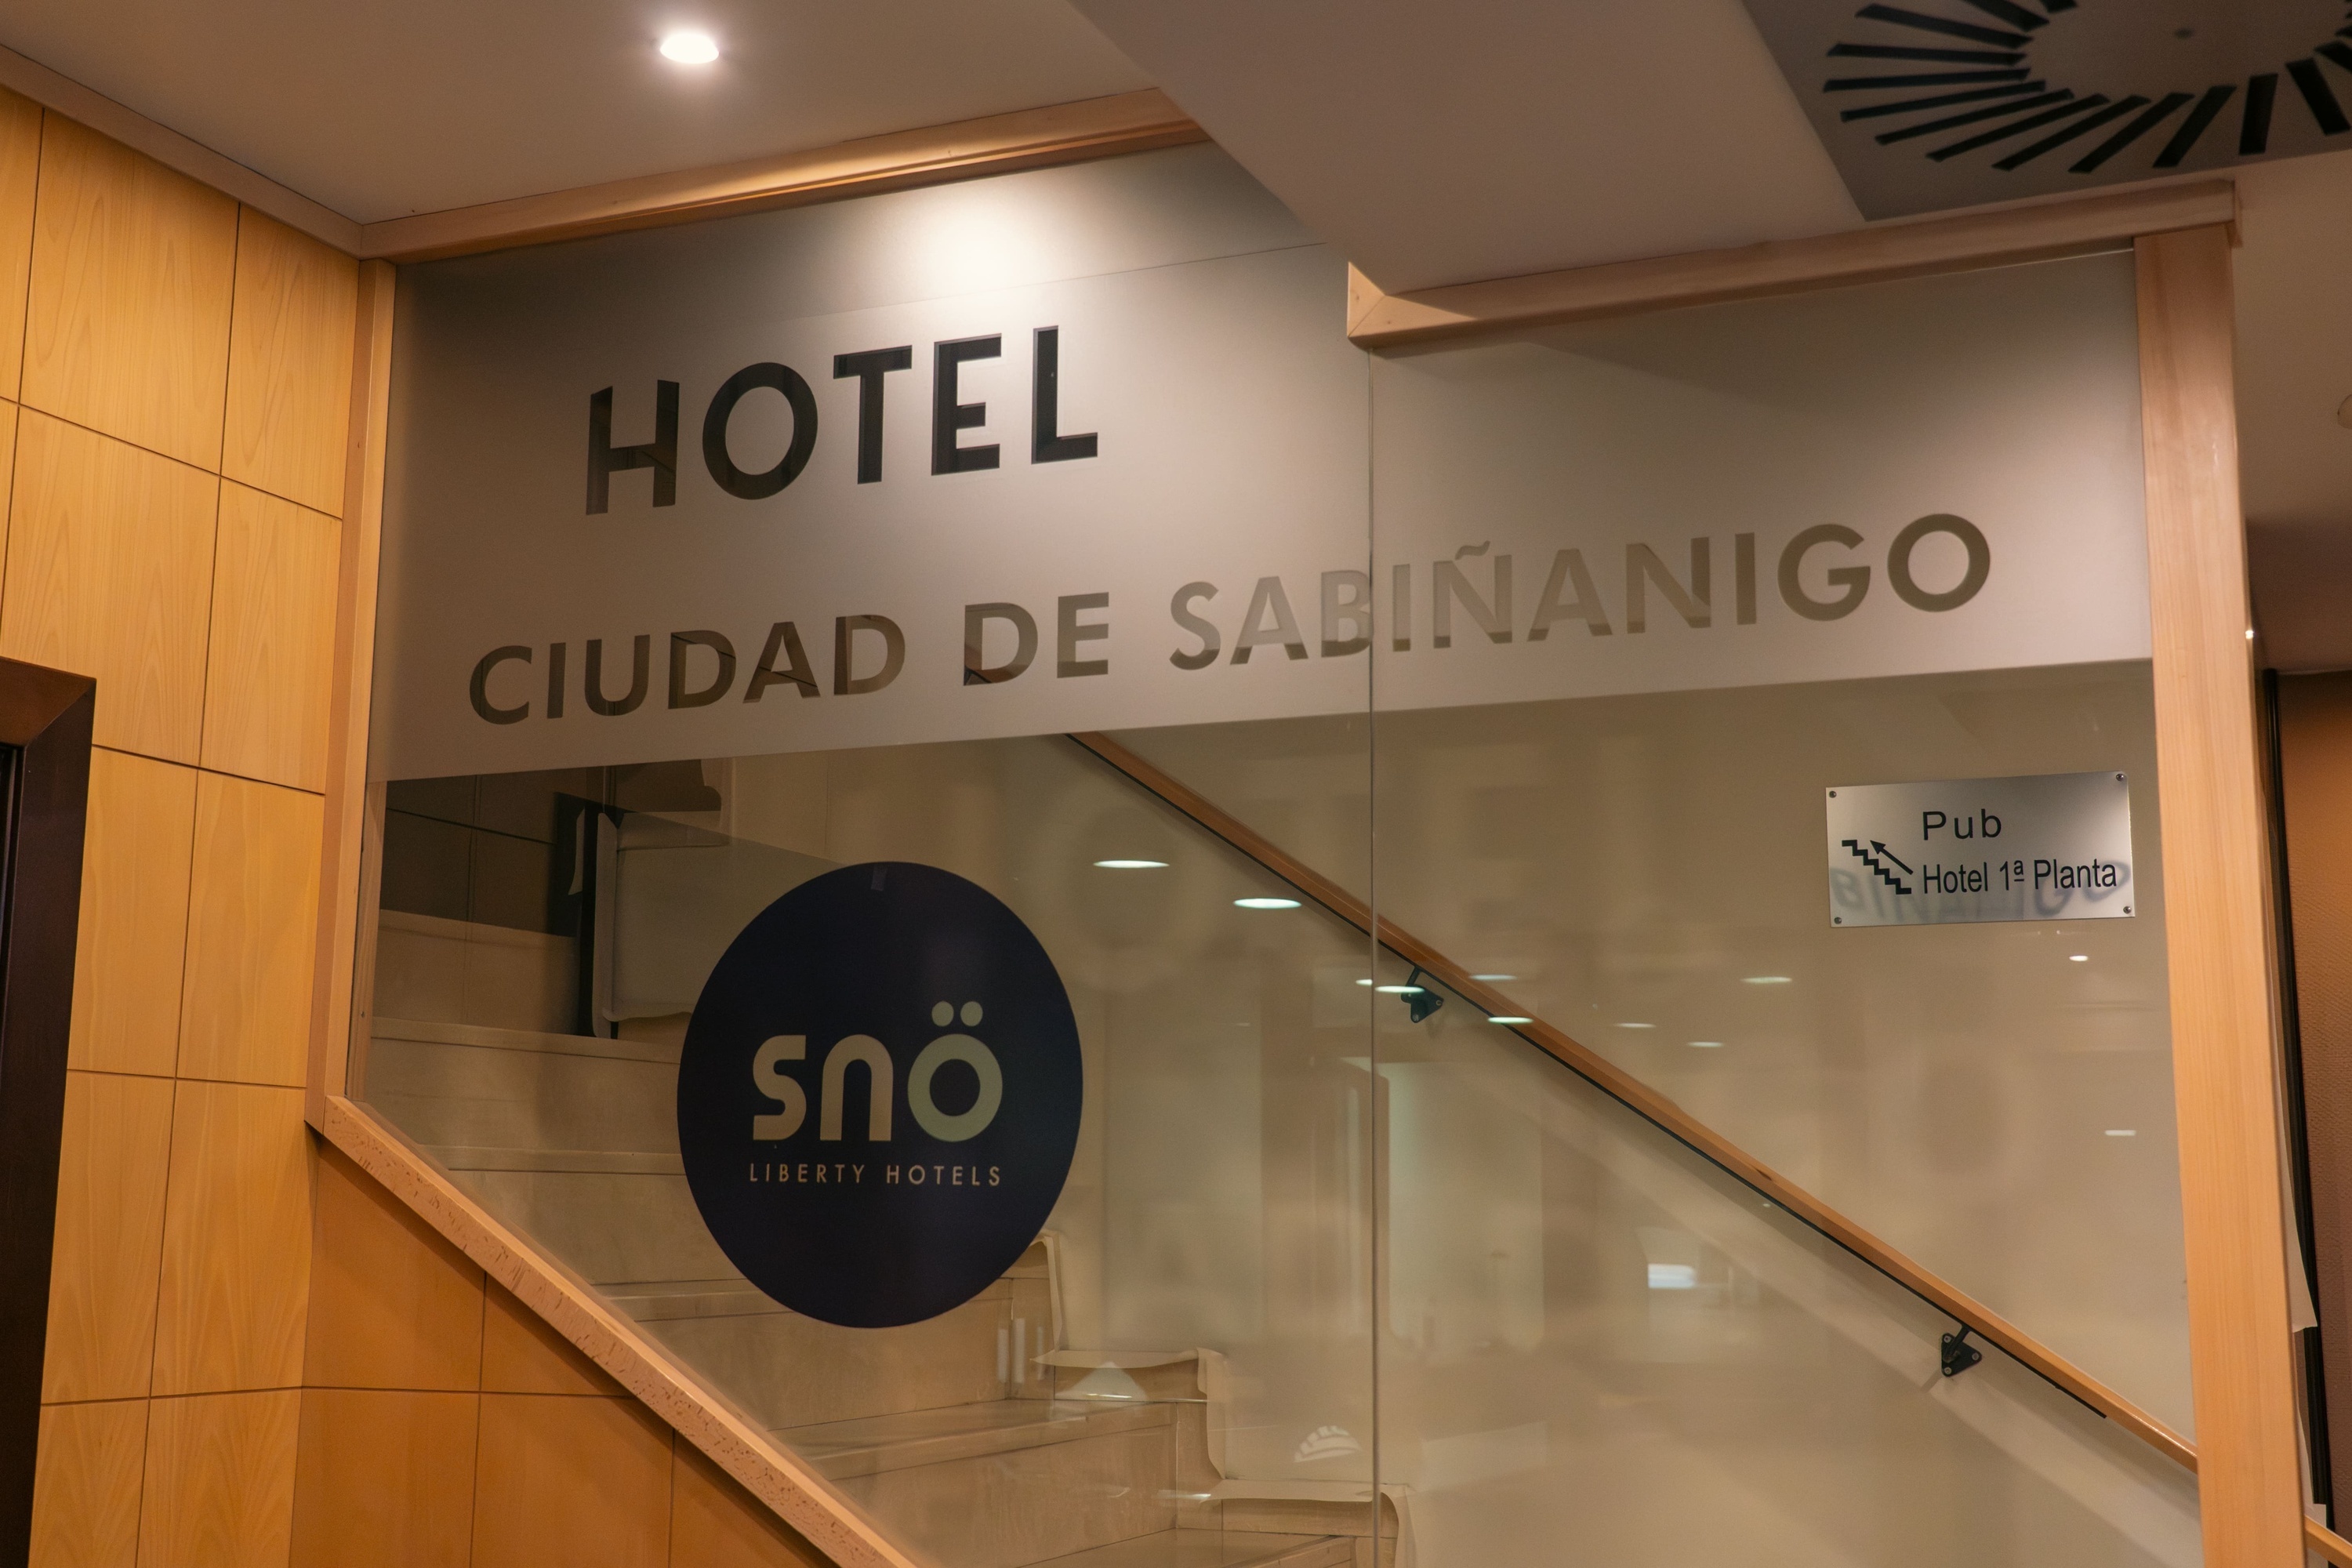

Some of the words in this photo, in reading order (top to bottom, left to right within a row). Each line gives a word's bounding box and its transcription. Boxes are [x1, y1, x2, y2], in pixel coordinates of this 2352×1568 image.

[586, 325, 1098, 516] HOTEL
[470, 614, 906, 724] CIUDAD
[963, 592, 1109, 687] DE
[1169, 513, 1991, 670] SABIÑANIGO
[1922, 808, 2002, 840] Pub
[1922, 862, 1988, 894] Hotel
[1999, 860, 2024, 891] 1ª
[2034, 858, 2117, 890] Planta
[750, 1163, 865, 1184] LIBERTY
[887, 1165, 1000, 1186] HOTELS
